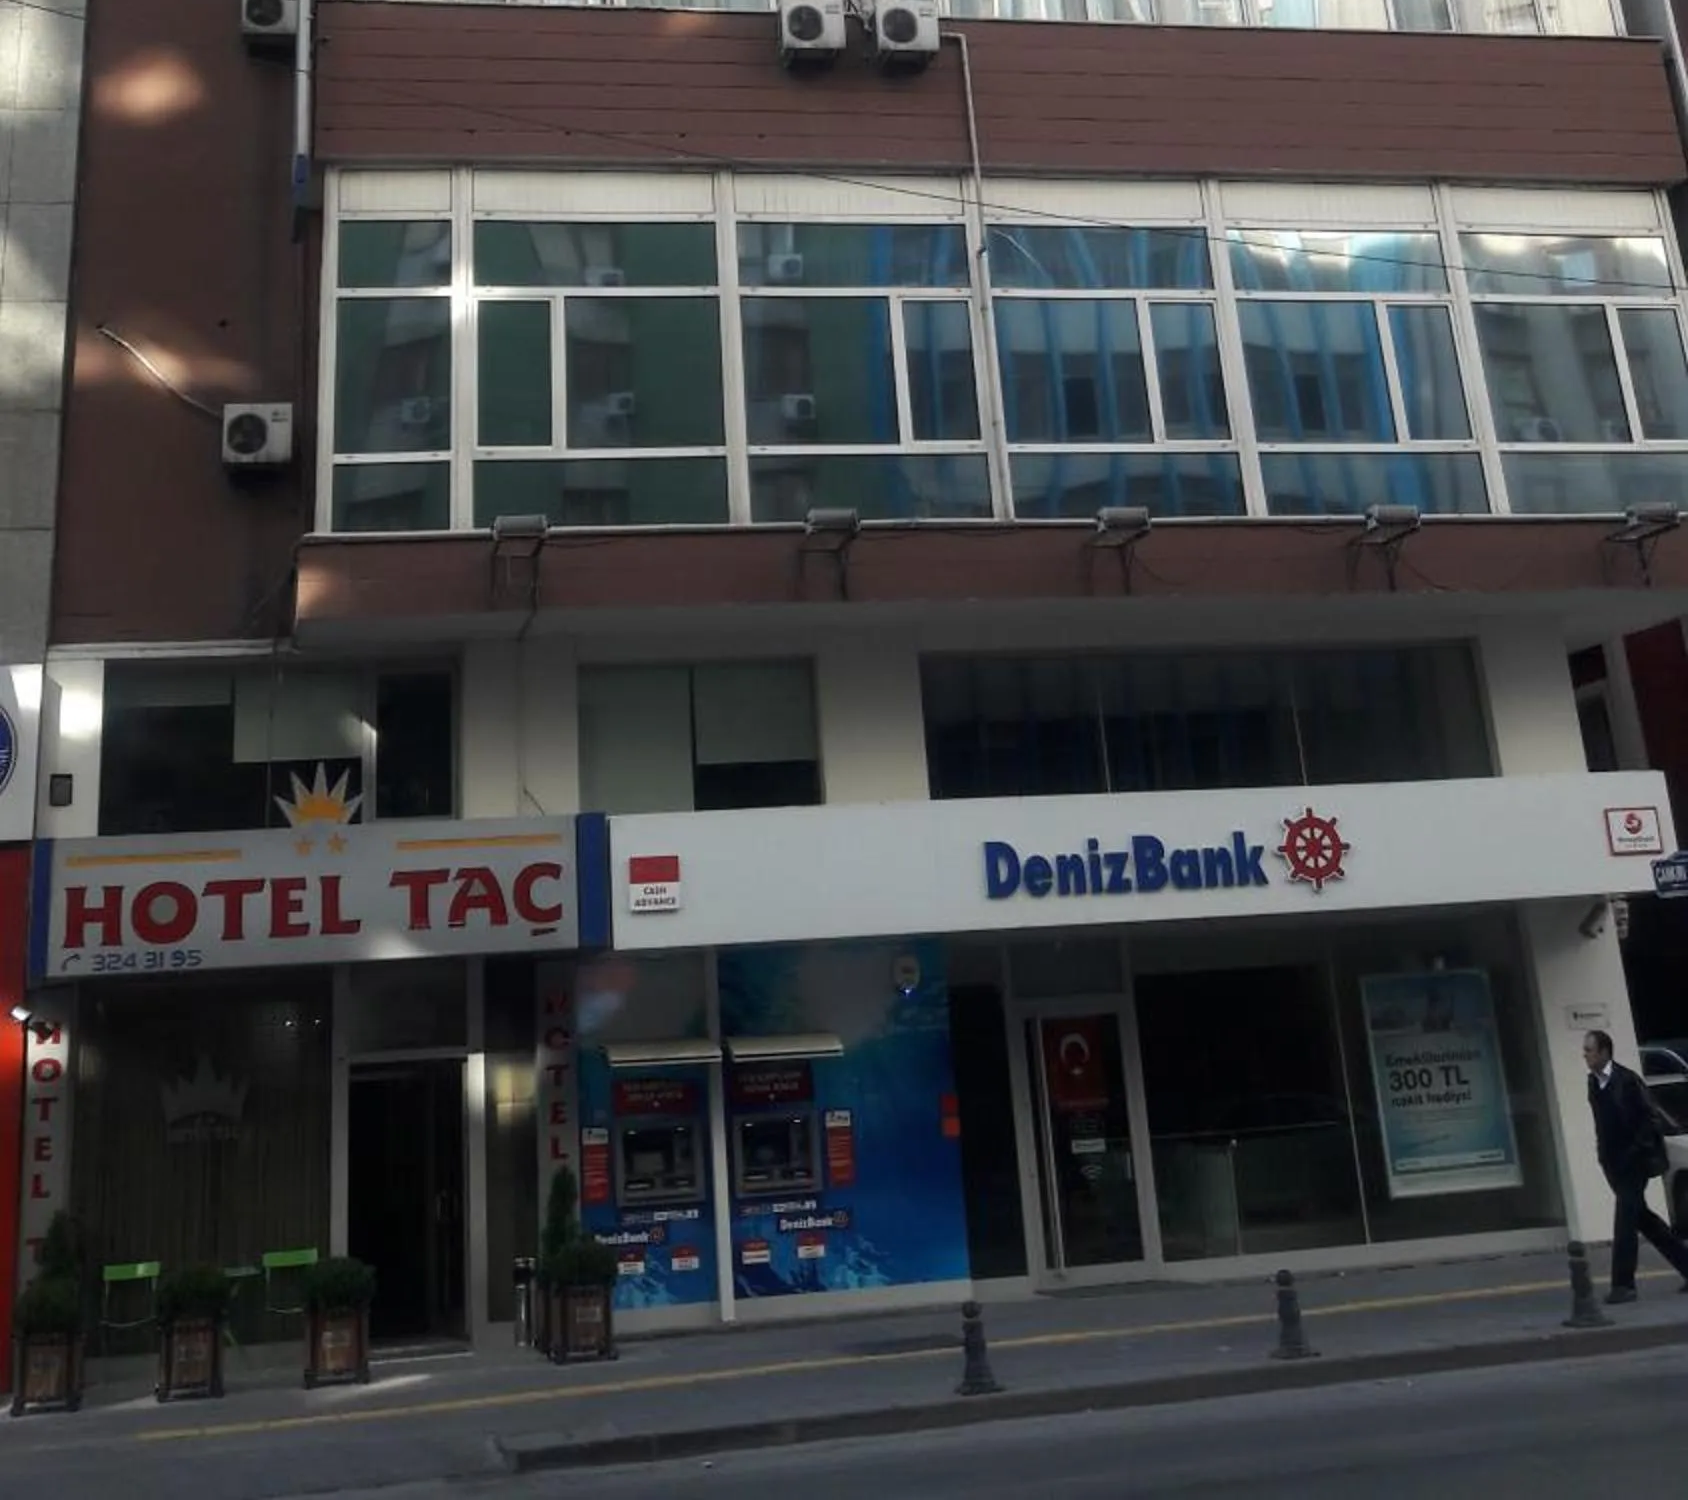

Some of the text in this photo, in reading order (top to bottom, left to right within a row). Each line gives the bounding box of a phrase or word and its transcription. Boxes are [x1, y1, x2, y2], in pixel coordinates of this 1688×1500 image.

[984, 831, 1269, 899] DenizBank
[62, 861, 563, 949] HOTEL TAÇ
[634, 896, 677, 908] ADVANCE
[643, 886, 668, 896] CASH
[91, 948, 203, 972] 324 31 95
[543, 990, 571, 1160] HOTEL
[1389, 1064, 1469, 1092] 300 TL
[30, 1021, 62, 1199] HOTEL
[779, 1214, 833, 1231] DenizBank
